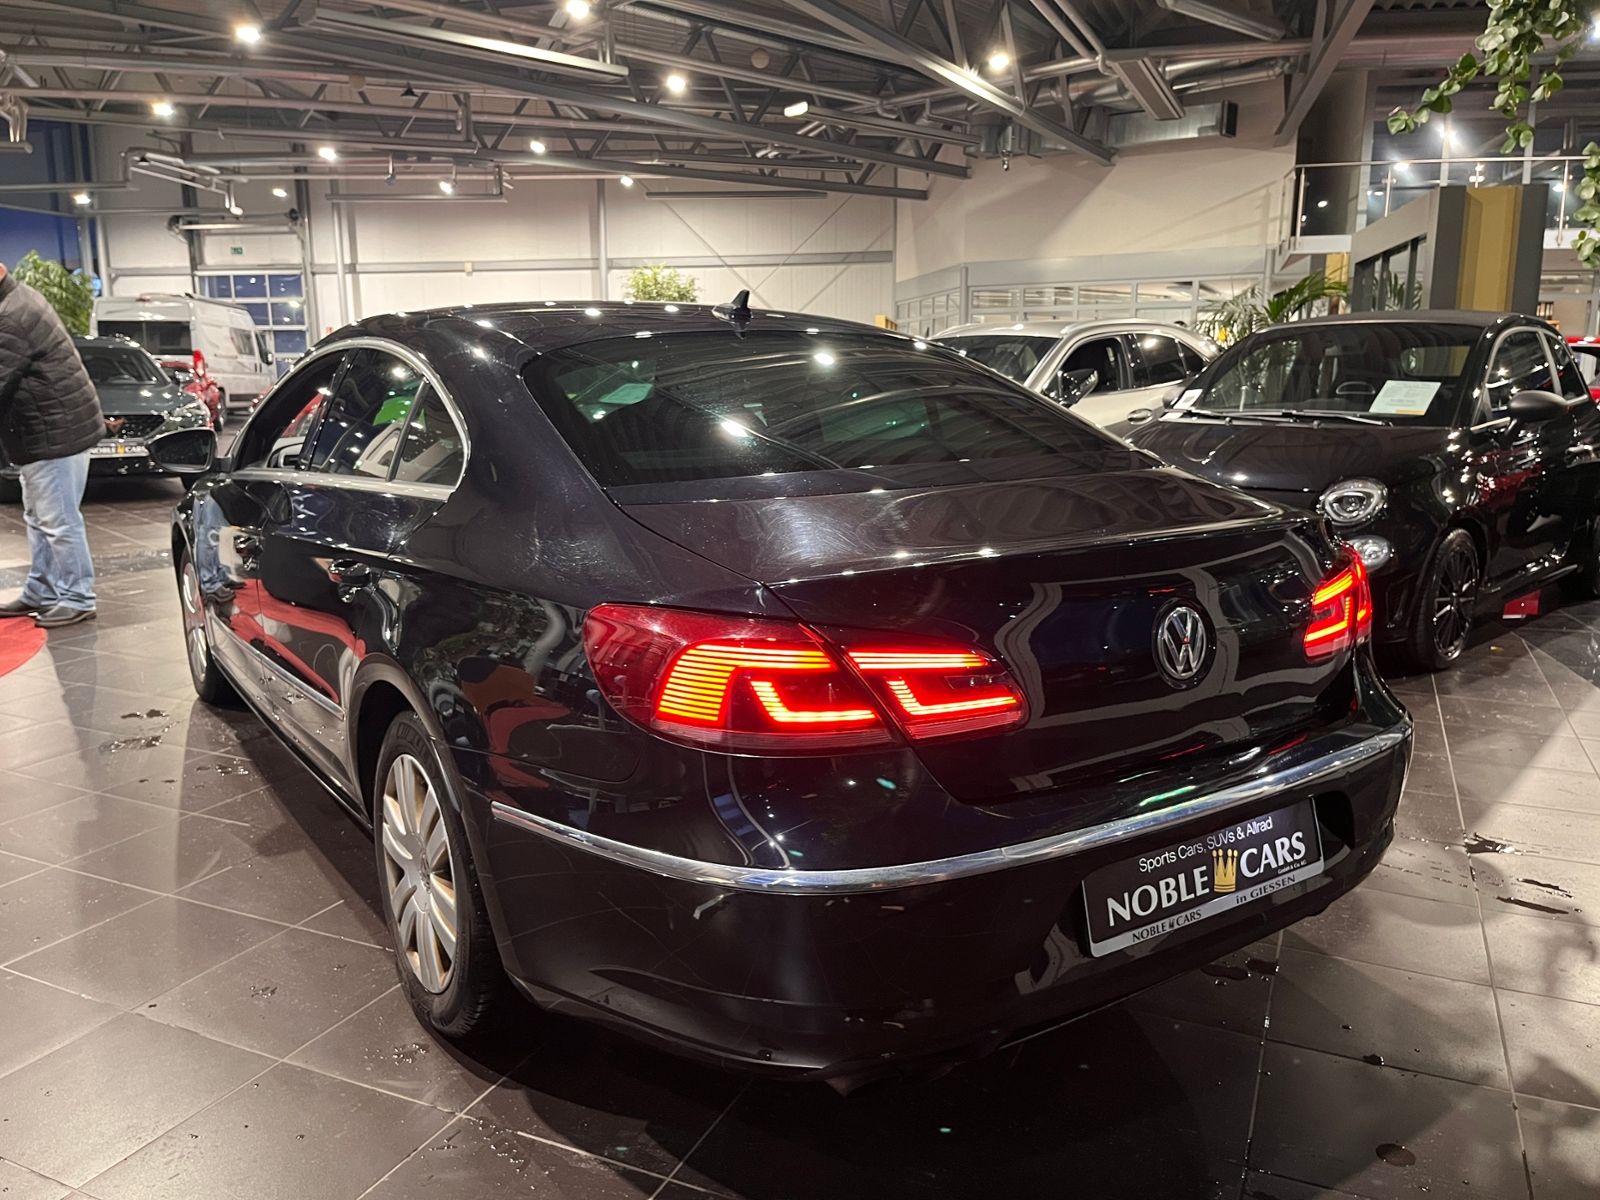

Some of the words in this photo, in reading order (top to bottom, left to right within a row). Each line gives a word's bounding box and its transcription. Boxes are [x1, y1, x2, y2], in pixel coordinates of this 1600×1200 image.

[1138, 850, 1177, 873] Sports
[1178, 841, 1206, 859] Cars,
[1207, 832, 1235, 850] SUVs
[1236, 827, 1245, 840] &
[1246, 816, 1273, 837] Allrad
[1106, 865, 1210, 927] NOBLE
[1240, 831, 1306, 878] CARS
[1235, 893, 1247, 905] in
[1250, 874, 1296, 899] GIESSEN
[1132, 923, 1167, 943] NOBLE
[1175, 909, 1202, 929] CARS
